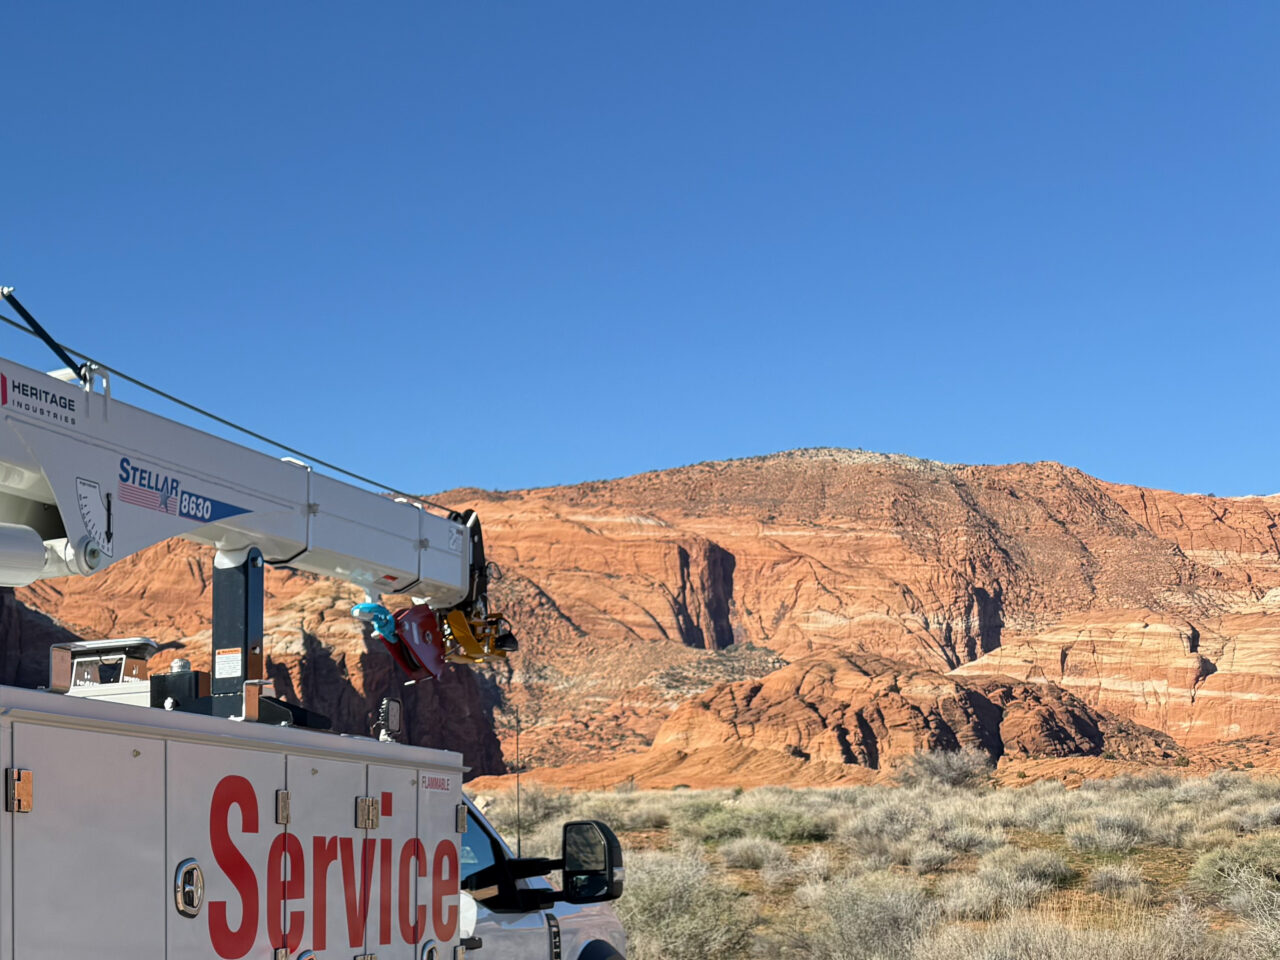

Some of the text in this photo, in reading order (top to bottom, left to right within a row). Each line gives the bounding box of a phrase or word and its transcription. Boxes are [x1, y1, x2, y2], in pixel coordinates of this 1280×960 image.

[11, 379, 76, 412] HERITAGE
[11, 399, 76, 425] INDUSTRIES
[118, 456, 212, 520] STELLAR 8630
[422, 776, 450, 791] FLAMMABLE
[208, 774, 459, 960] Service
